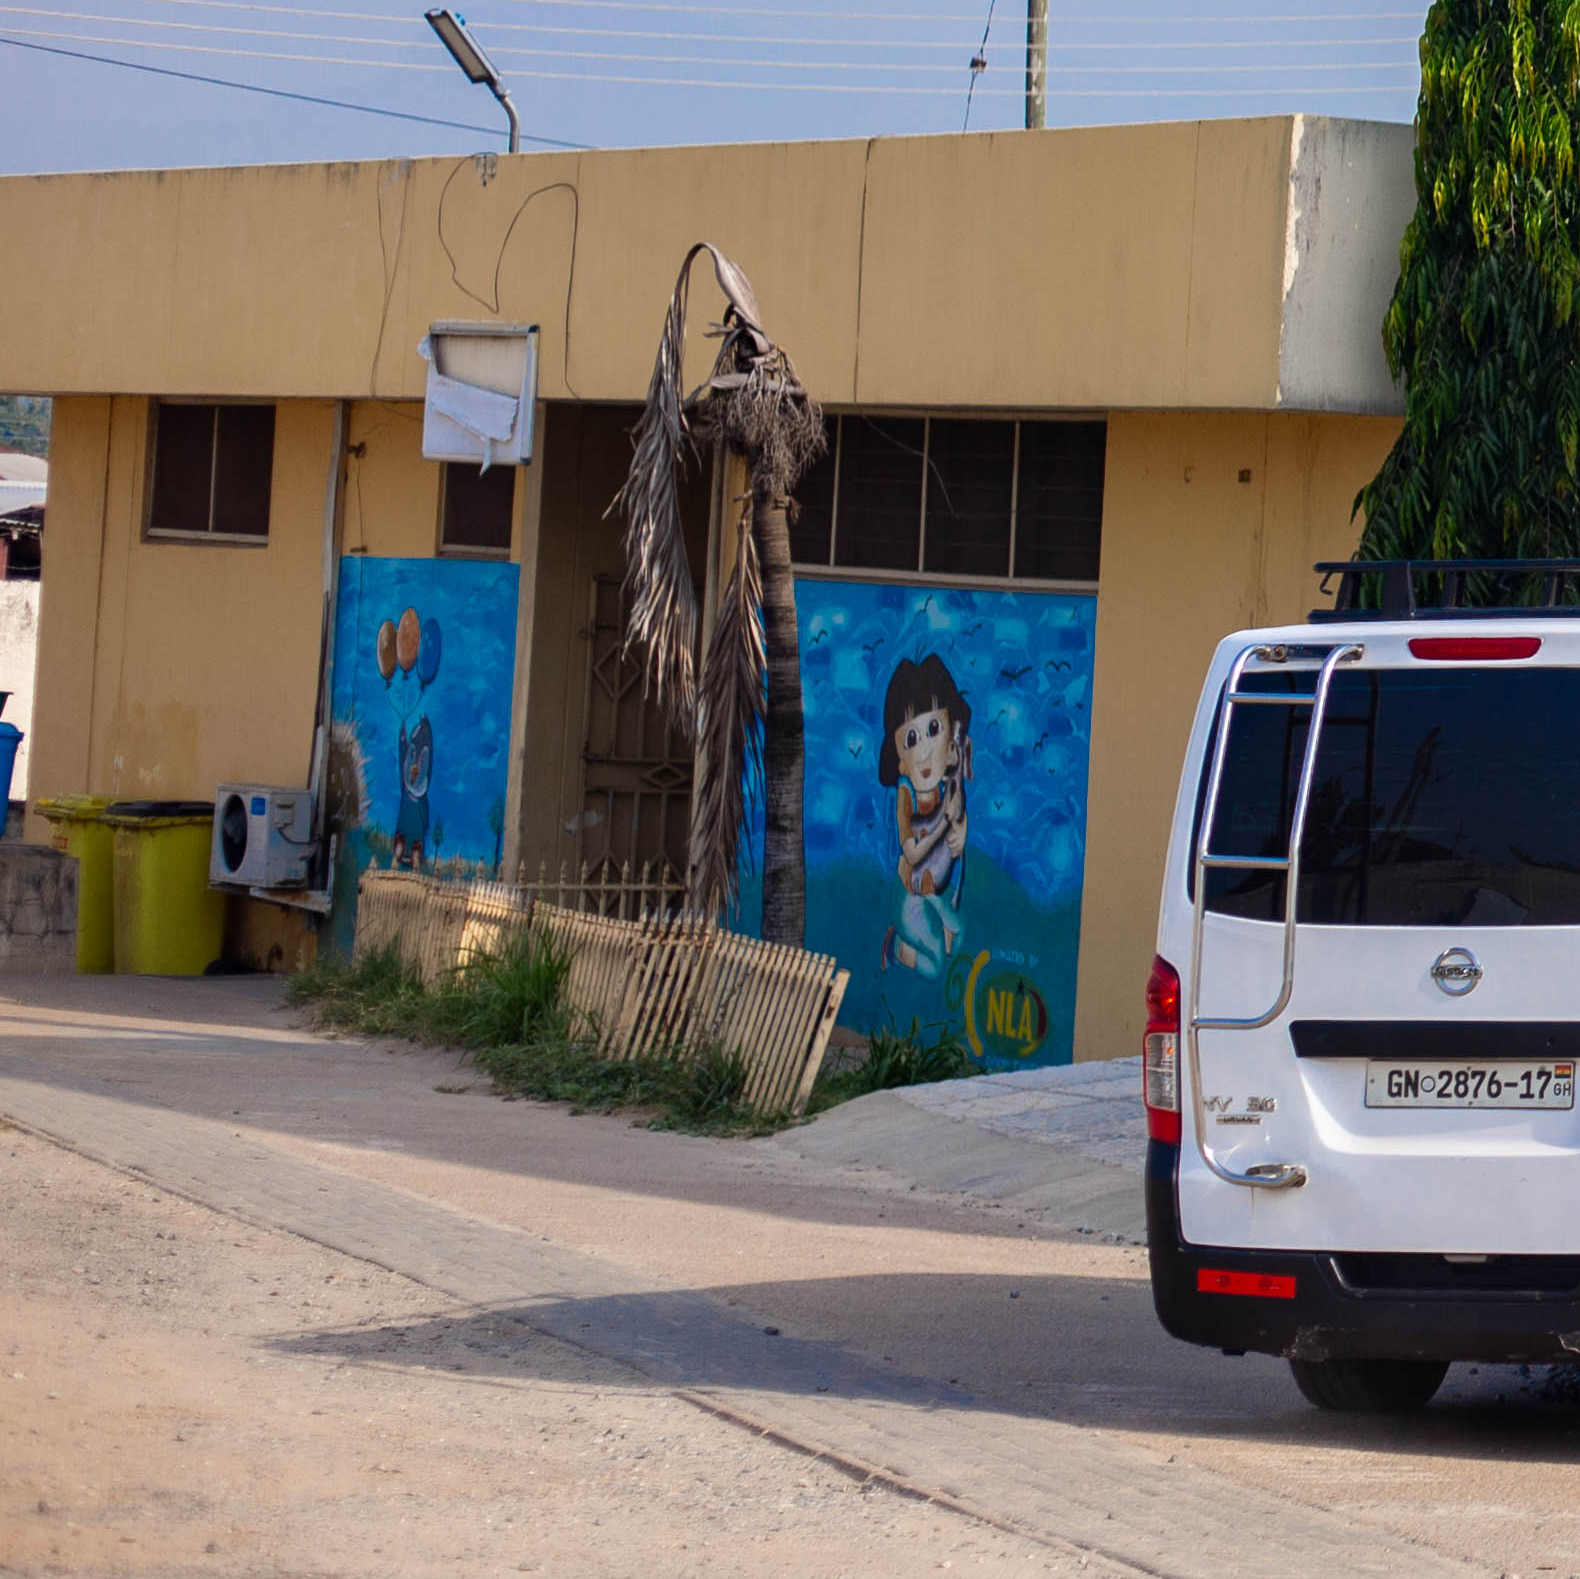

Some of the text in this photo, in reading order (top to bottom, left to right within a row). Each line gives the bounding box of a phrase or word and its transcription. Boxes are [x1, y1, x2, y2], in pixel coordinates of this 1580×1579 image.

[986, 987, 1033, 1041] NLA
[1387, 1070, 1552, 1099] GN 2876-17
[1553, 1082, 1572, 1097] GH
